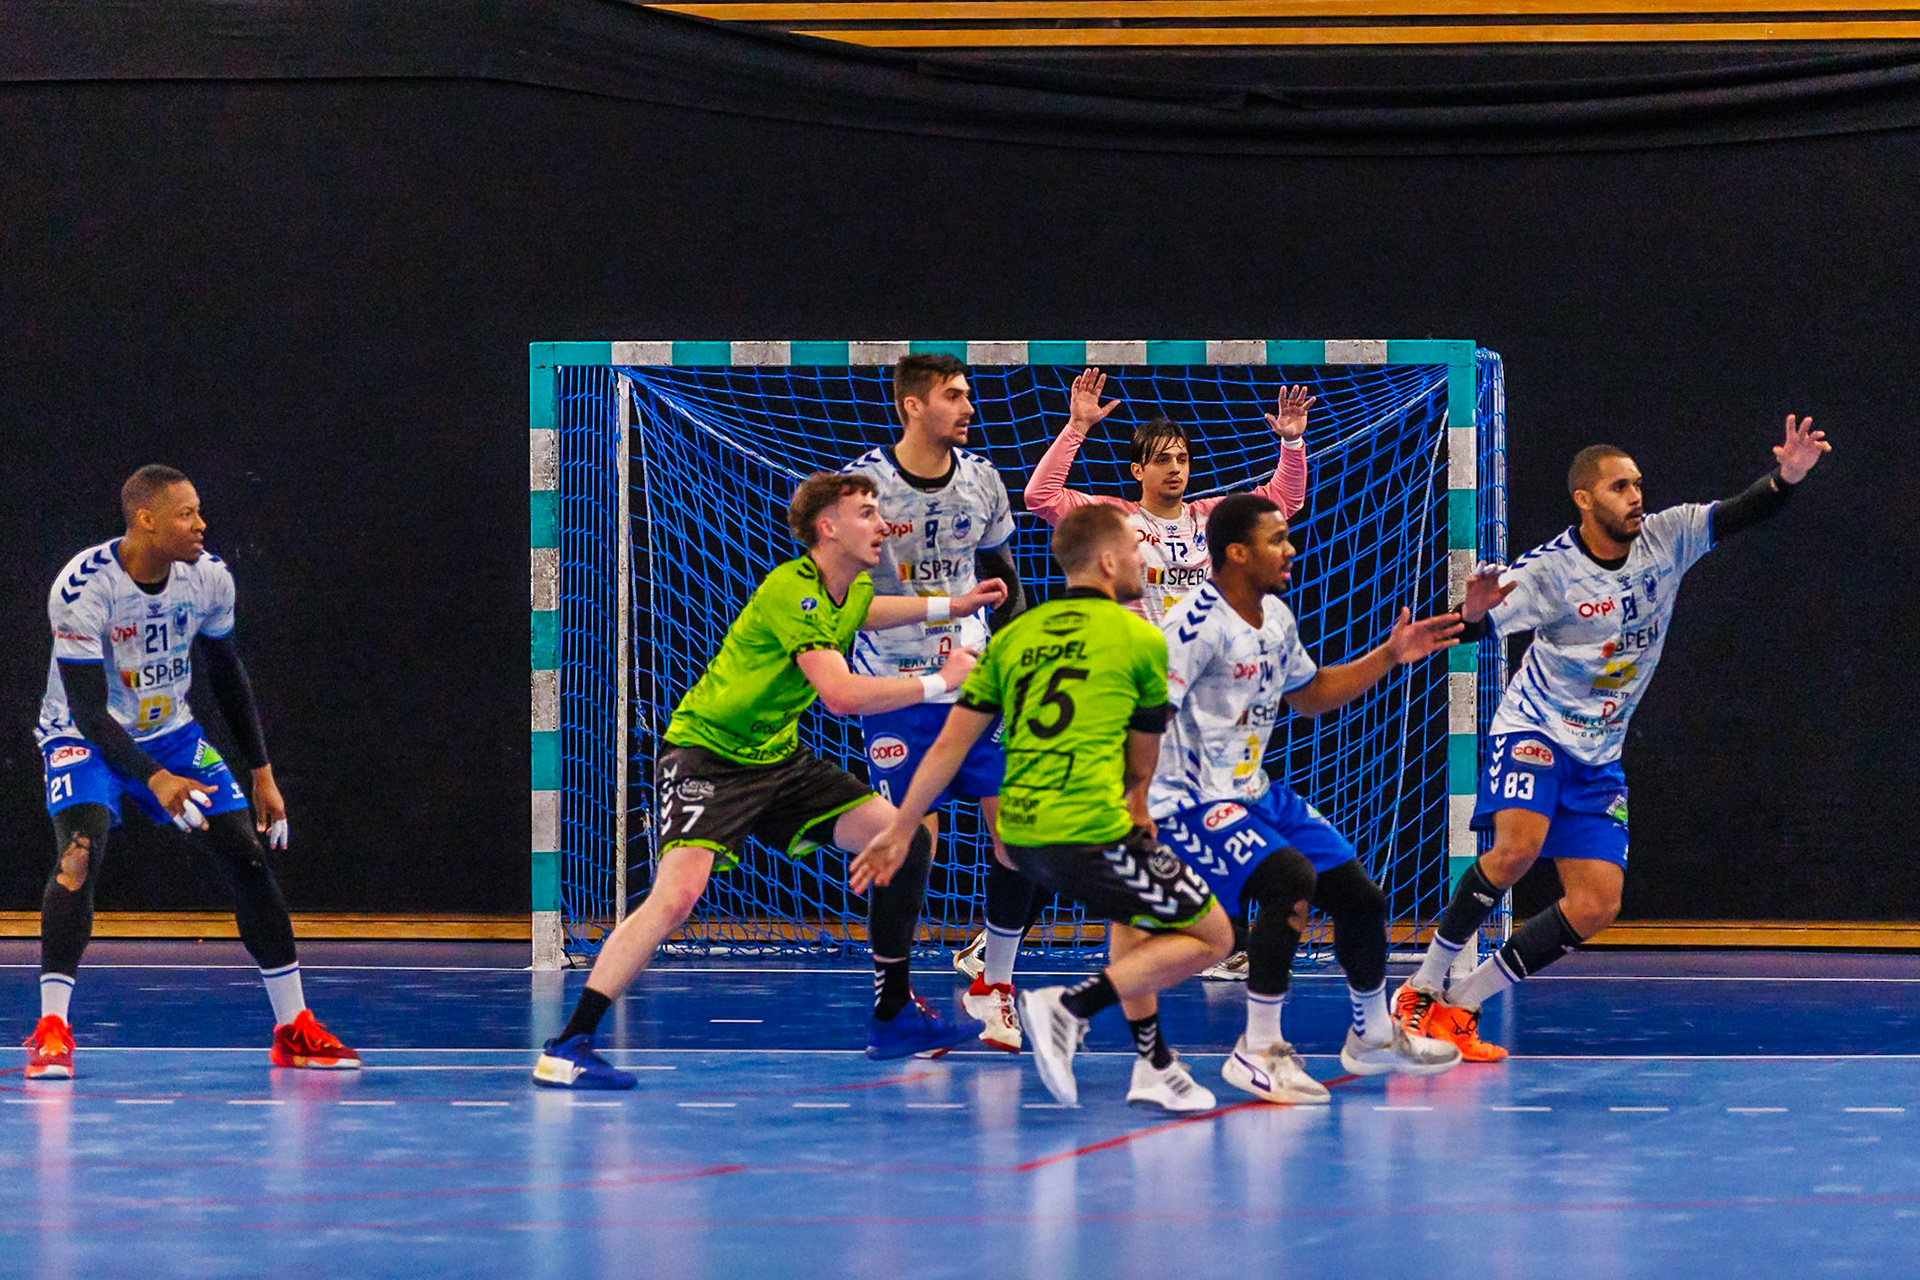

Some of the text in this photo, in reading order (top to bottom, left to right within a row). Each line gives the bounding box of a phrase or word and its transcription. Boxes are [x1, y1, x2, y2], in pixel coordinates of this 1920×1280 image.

[1578, 596, 1615, 618] Orpi
[145, 623, 168, 654] 21
[1009, 667, 1091, 739] 15
[871, 744, 904, 760] cora
[1513, 746, 1552, 762] cora
[51, 773, 73, 804] 21
[1504, 772, 1535, 800] 83
[681, 805, 705, 833] 7
[1223, 829, 1267, 866] 24
